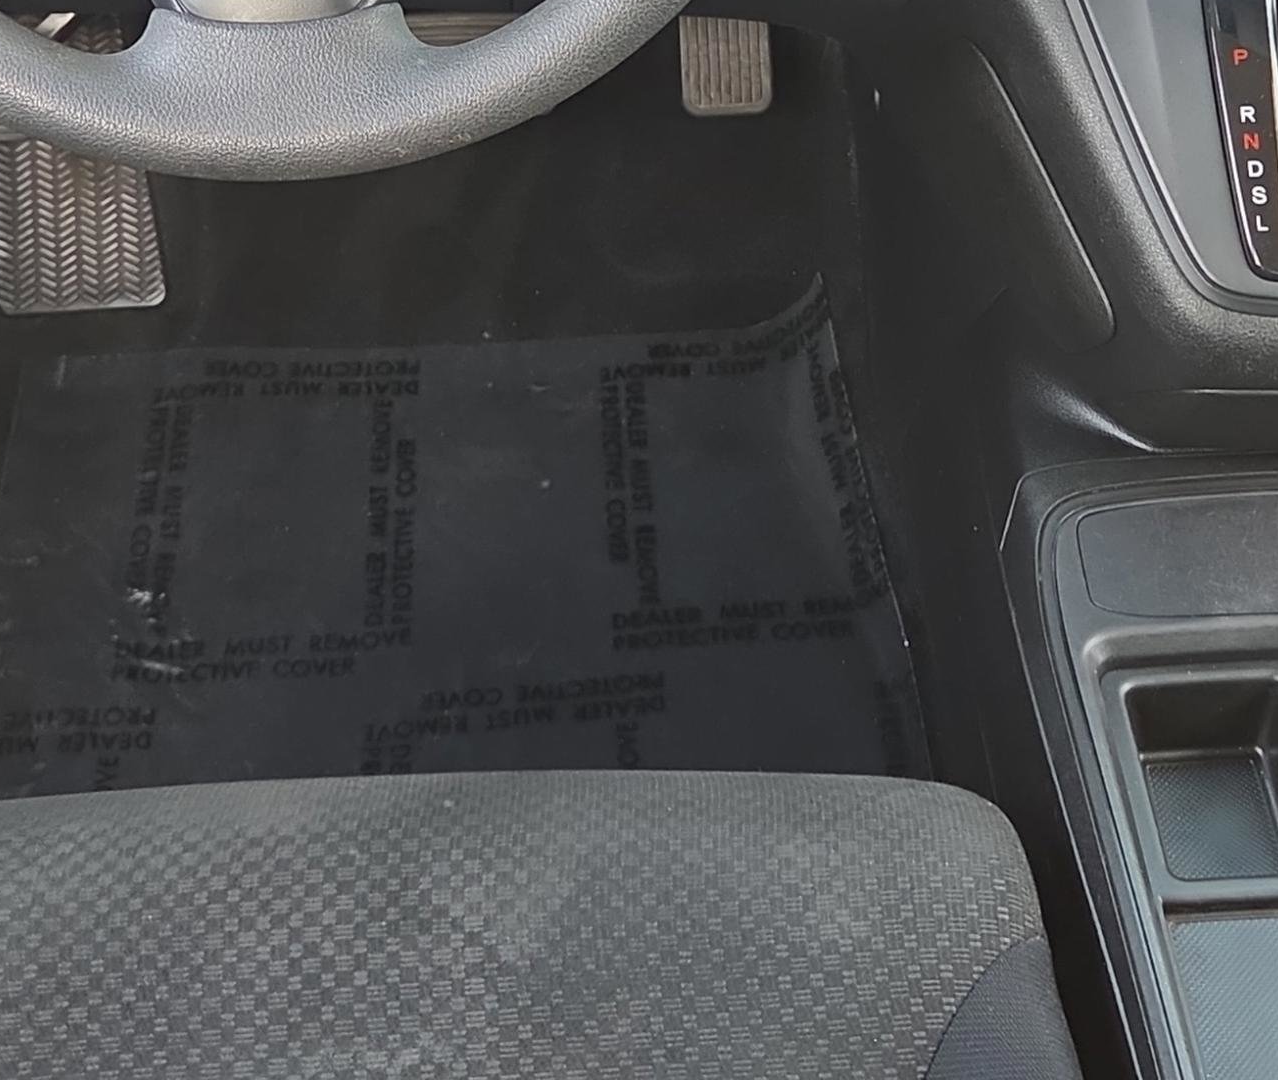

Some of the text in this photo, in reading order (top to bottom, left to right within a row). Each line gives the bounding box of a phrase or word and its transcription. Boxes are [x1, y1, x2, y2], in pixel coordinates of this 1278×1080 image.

[1233, 48, 1249, 65] P
[1239, 105, 1256, 123] R
[1243, 132, 1260, 149] N
[1248, 160, 1264, 178] D
[1251, 185, 1269, 205] S
[1256, 214, 1270, 232] L
[204, 358, 421, 378] PROTECTIVE COVER
[260, 381, 322, 396] MUST
[225, 627, 412, 655] MUST REMOVE
[272, 657, 357, 678] COVER
